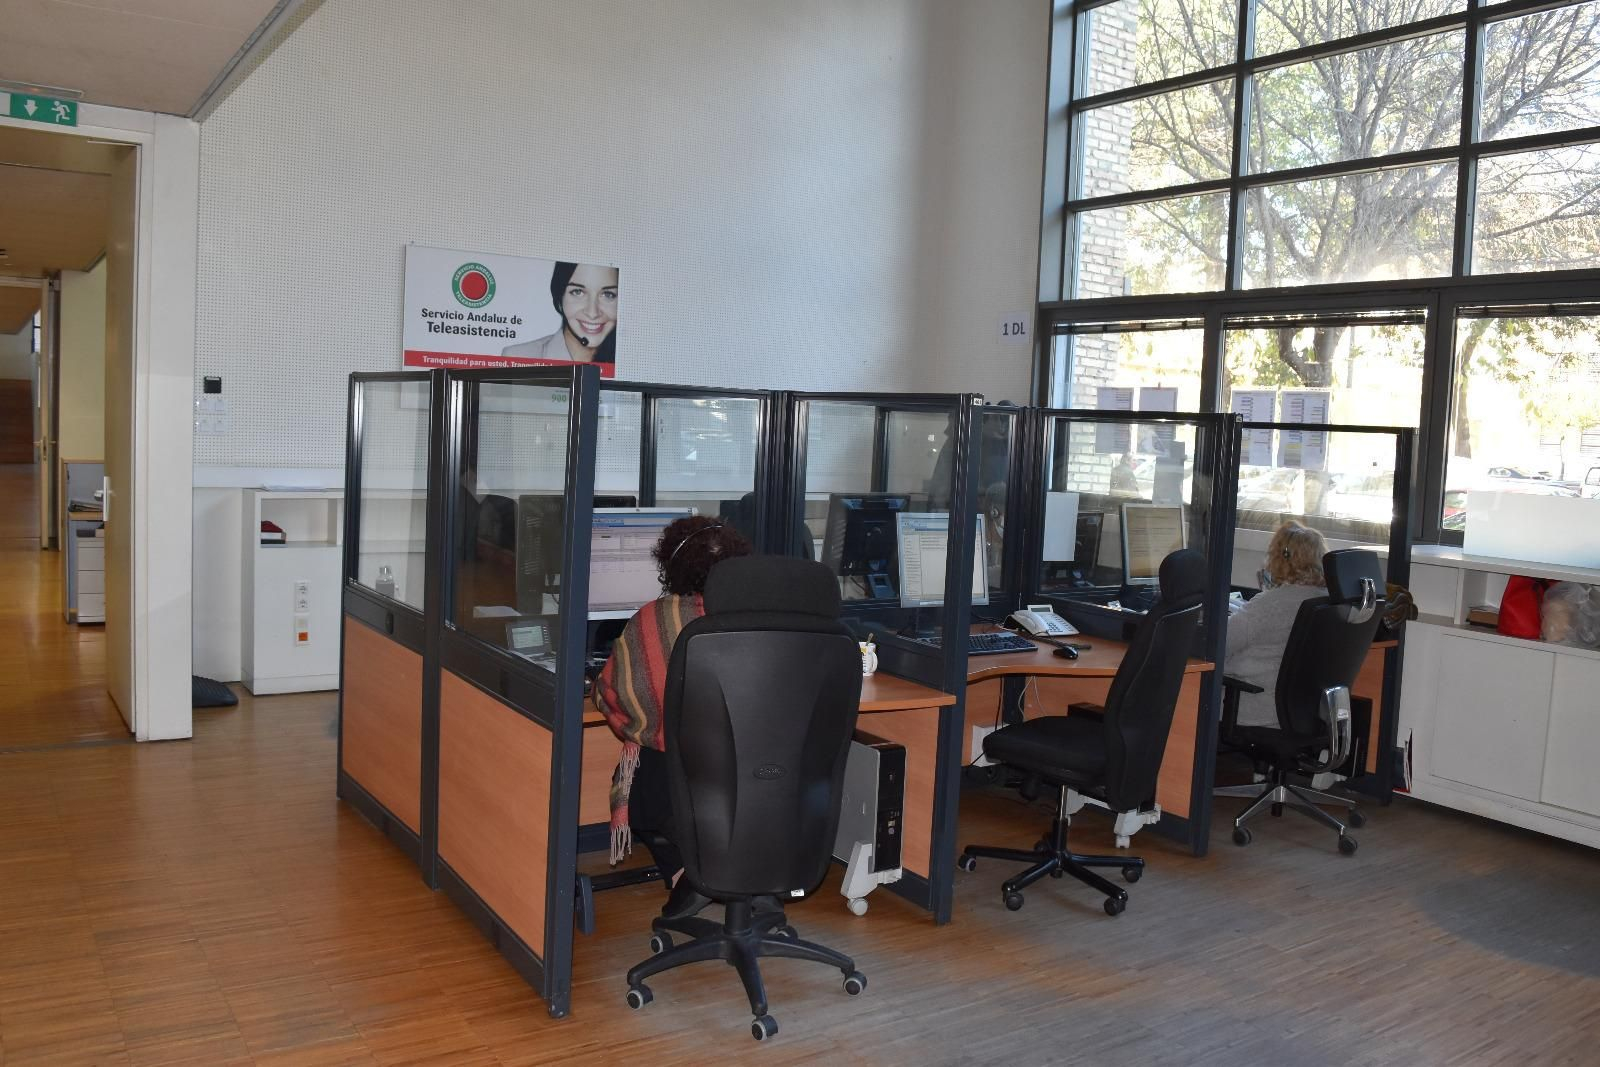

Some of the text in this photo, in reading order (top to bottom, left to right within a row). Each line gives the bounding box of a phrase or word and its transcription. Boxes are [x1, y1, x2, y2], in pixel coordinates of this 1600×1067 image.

[421, 308, 522, 325] Servicio Andaluz de
[427, 321, 516, 339] Teleasistencia
[1003, 322, 1026, 335] 1 DL
[423, 355, 468, 366] Tranquilidad
[469, 359, 486, 367] para
